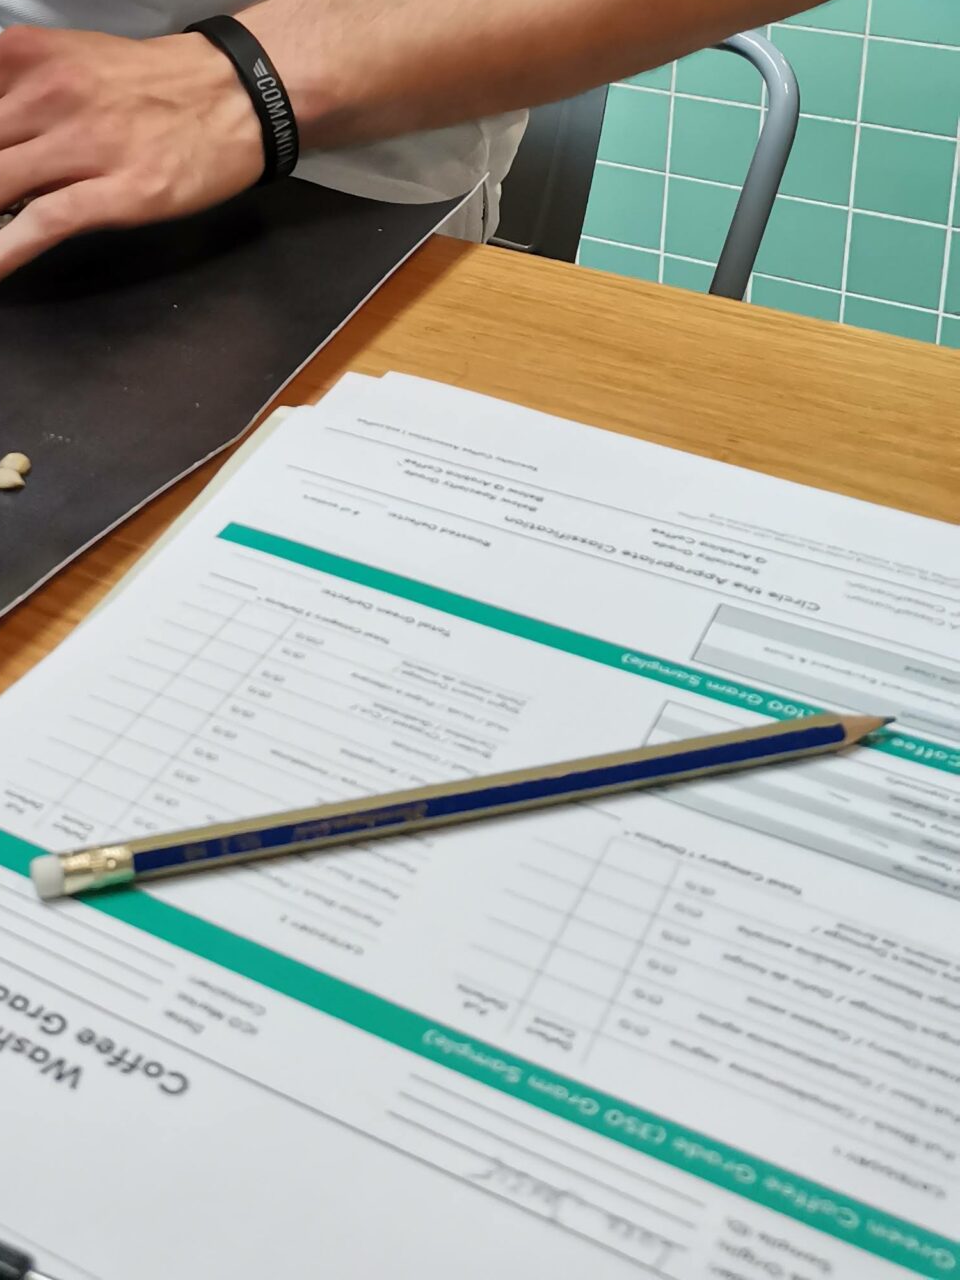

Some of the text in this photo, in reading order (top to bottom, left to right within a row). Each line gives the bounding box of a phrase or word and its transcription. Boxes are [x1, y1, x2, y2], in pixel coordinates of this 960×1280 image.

[404, 458, 443, 473] Coffee
[442, 480, 496, 500] Specialty
[650, 527, 696, 544] Coffee
[504, 515, 820, 611] Circle the Appropriate Classification
[697, 552, 759, 574] Specialty
[416, 621, 450, 637] Total
[621, 653, 701, 686] Sample)
[705, 681, 763, 705] Gram
[891, 738, 960, 767] Coffee
[75, 1028, 189, 1096] Coffee
[422, 1029, 956, 1270] Green Coffee Grade (350 Gram Sample)
